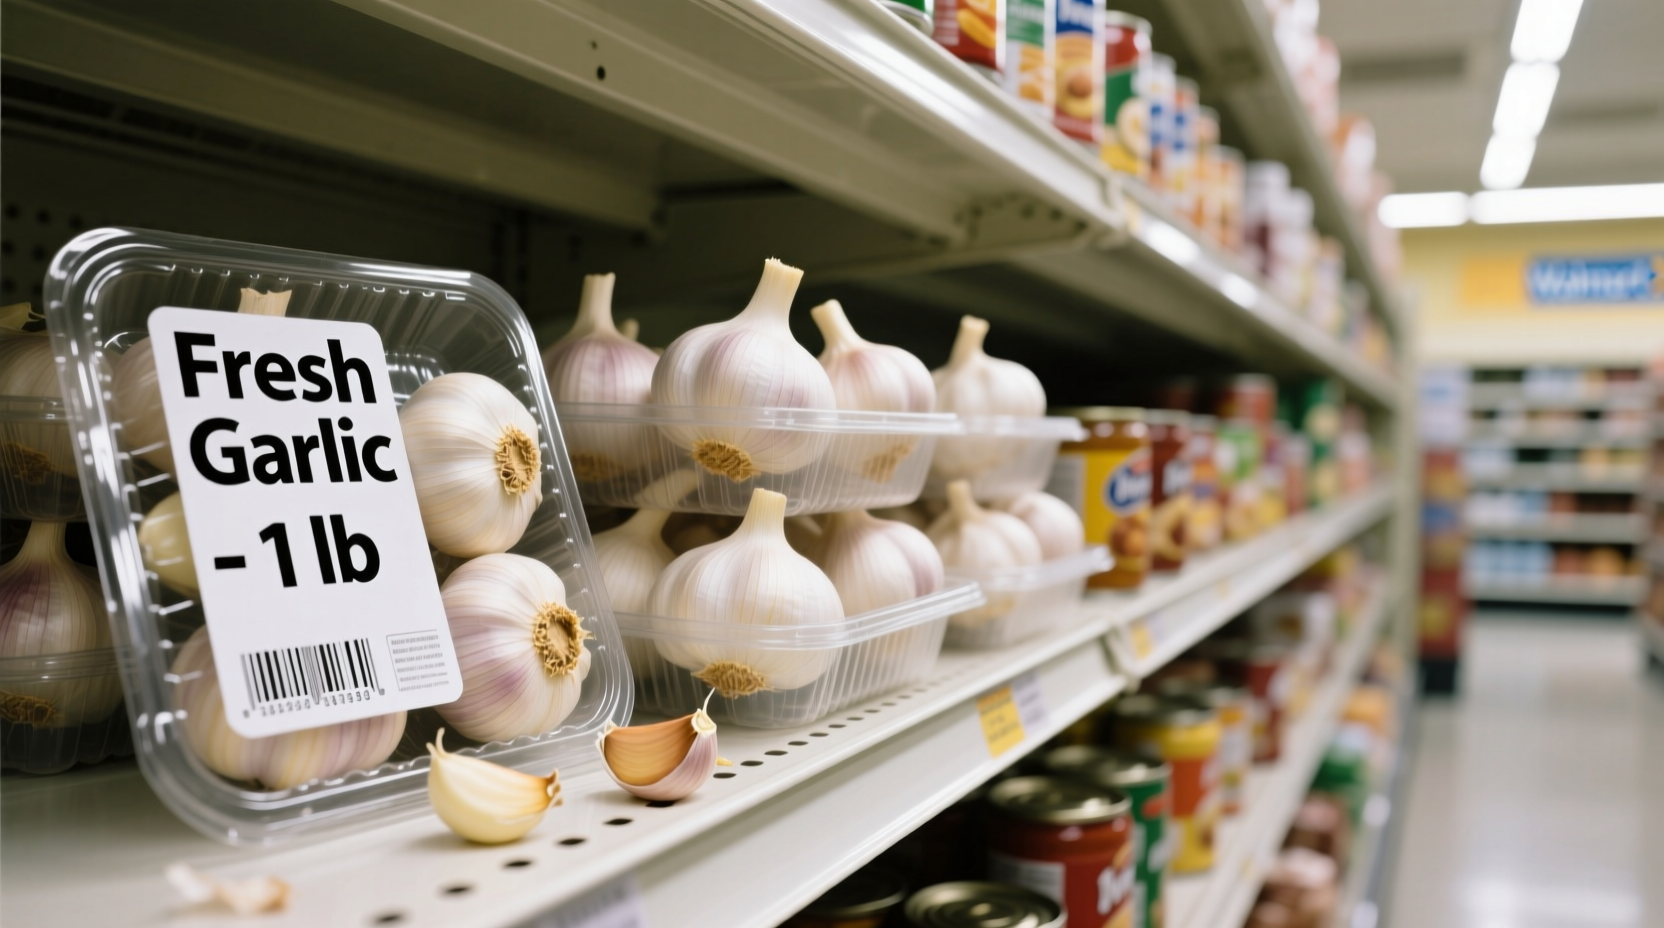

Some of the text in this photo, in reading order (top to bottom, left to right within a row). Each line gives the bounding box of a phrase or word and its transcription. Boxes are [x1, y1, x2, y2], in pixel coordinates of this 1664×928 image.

[173, 331, 377, 404] Fresh
[189, 416, 398, 486] Garlic
[258, 522, 298, 588] 1
[309, 514, 381, 585] lb
